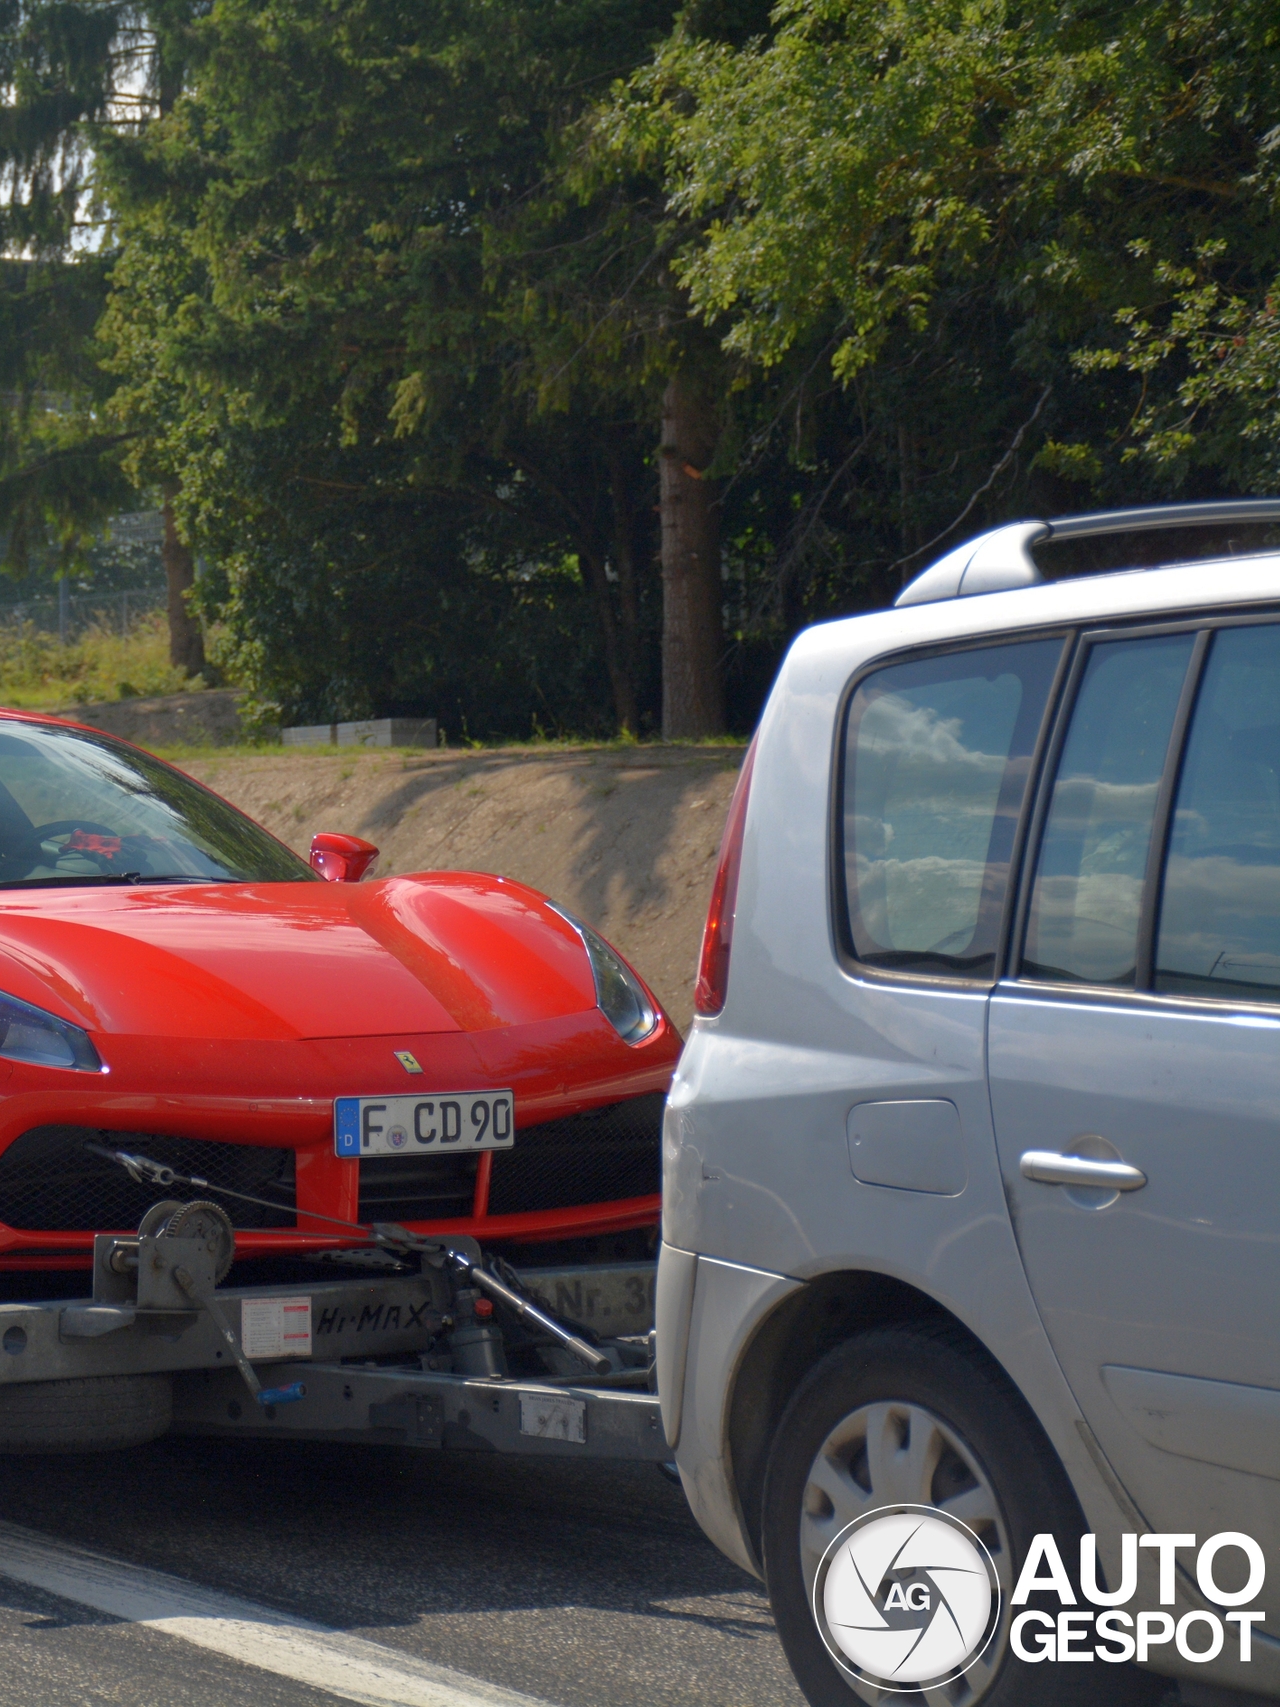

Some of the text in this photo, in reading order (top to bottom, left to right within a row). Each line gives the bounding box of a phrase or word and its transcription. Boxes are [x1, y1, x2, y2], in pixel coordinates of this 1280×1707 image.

[344, 1134, 353, 1147] D
[362, 1098, 511, 1147] F CD 90
[556, 1280, 612, 1318] Nr.
